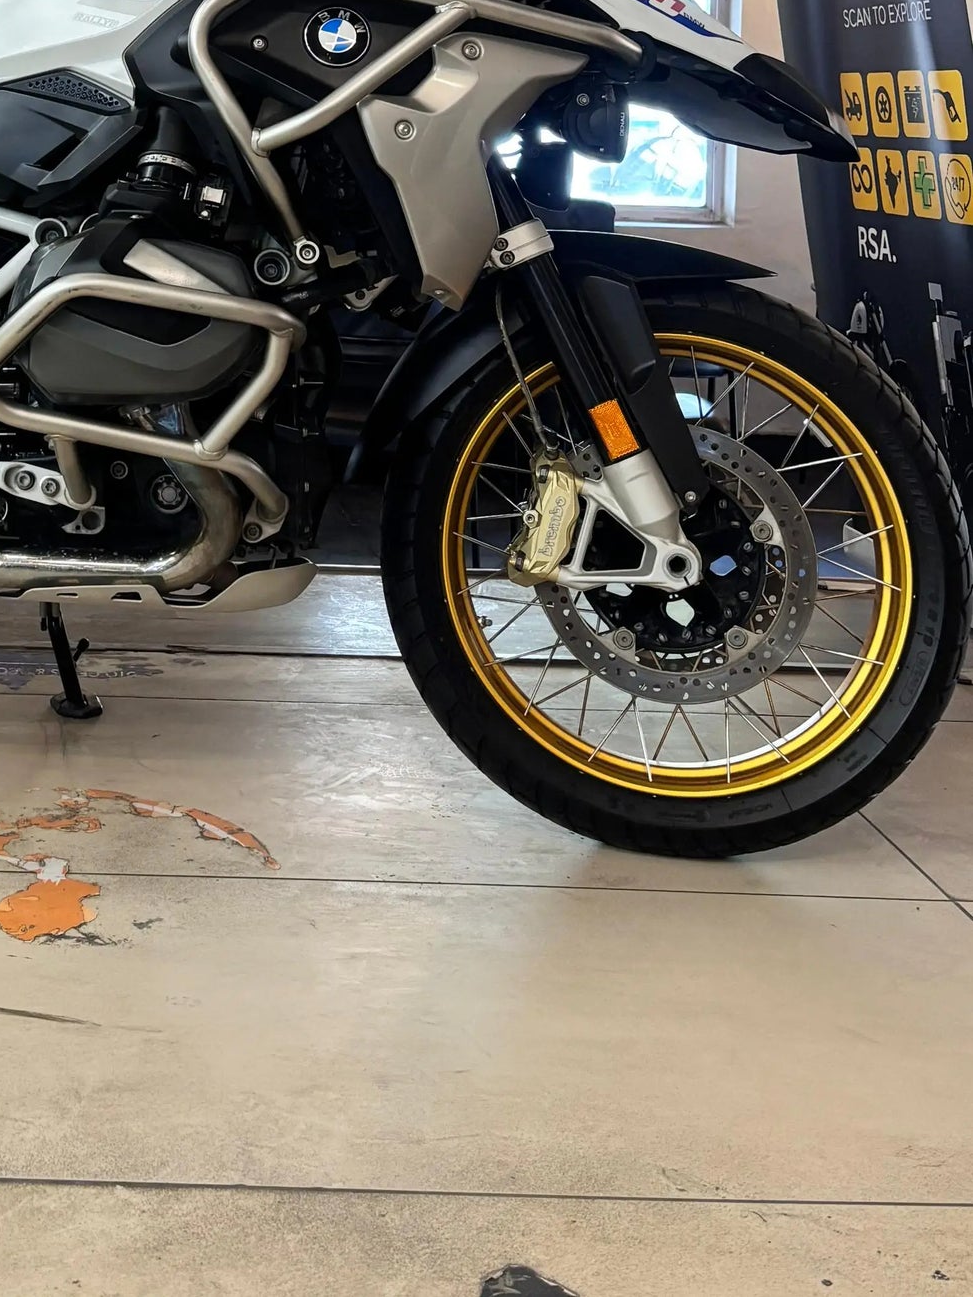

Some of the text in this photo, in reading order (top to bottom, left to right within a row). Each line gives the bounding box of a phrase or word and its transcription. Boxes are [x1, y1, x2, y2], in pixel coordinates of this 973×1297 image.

[318, 10, 367, 33] BMW
[842, 0, 932, 28] SCAN TO EXPLORE
[857, 225, 897, 264] RSA.
[538, 496, 567, 557] brembo
